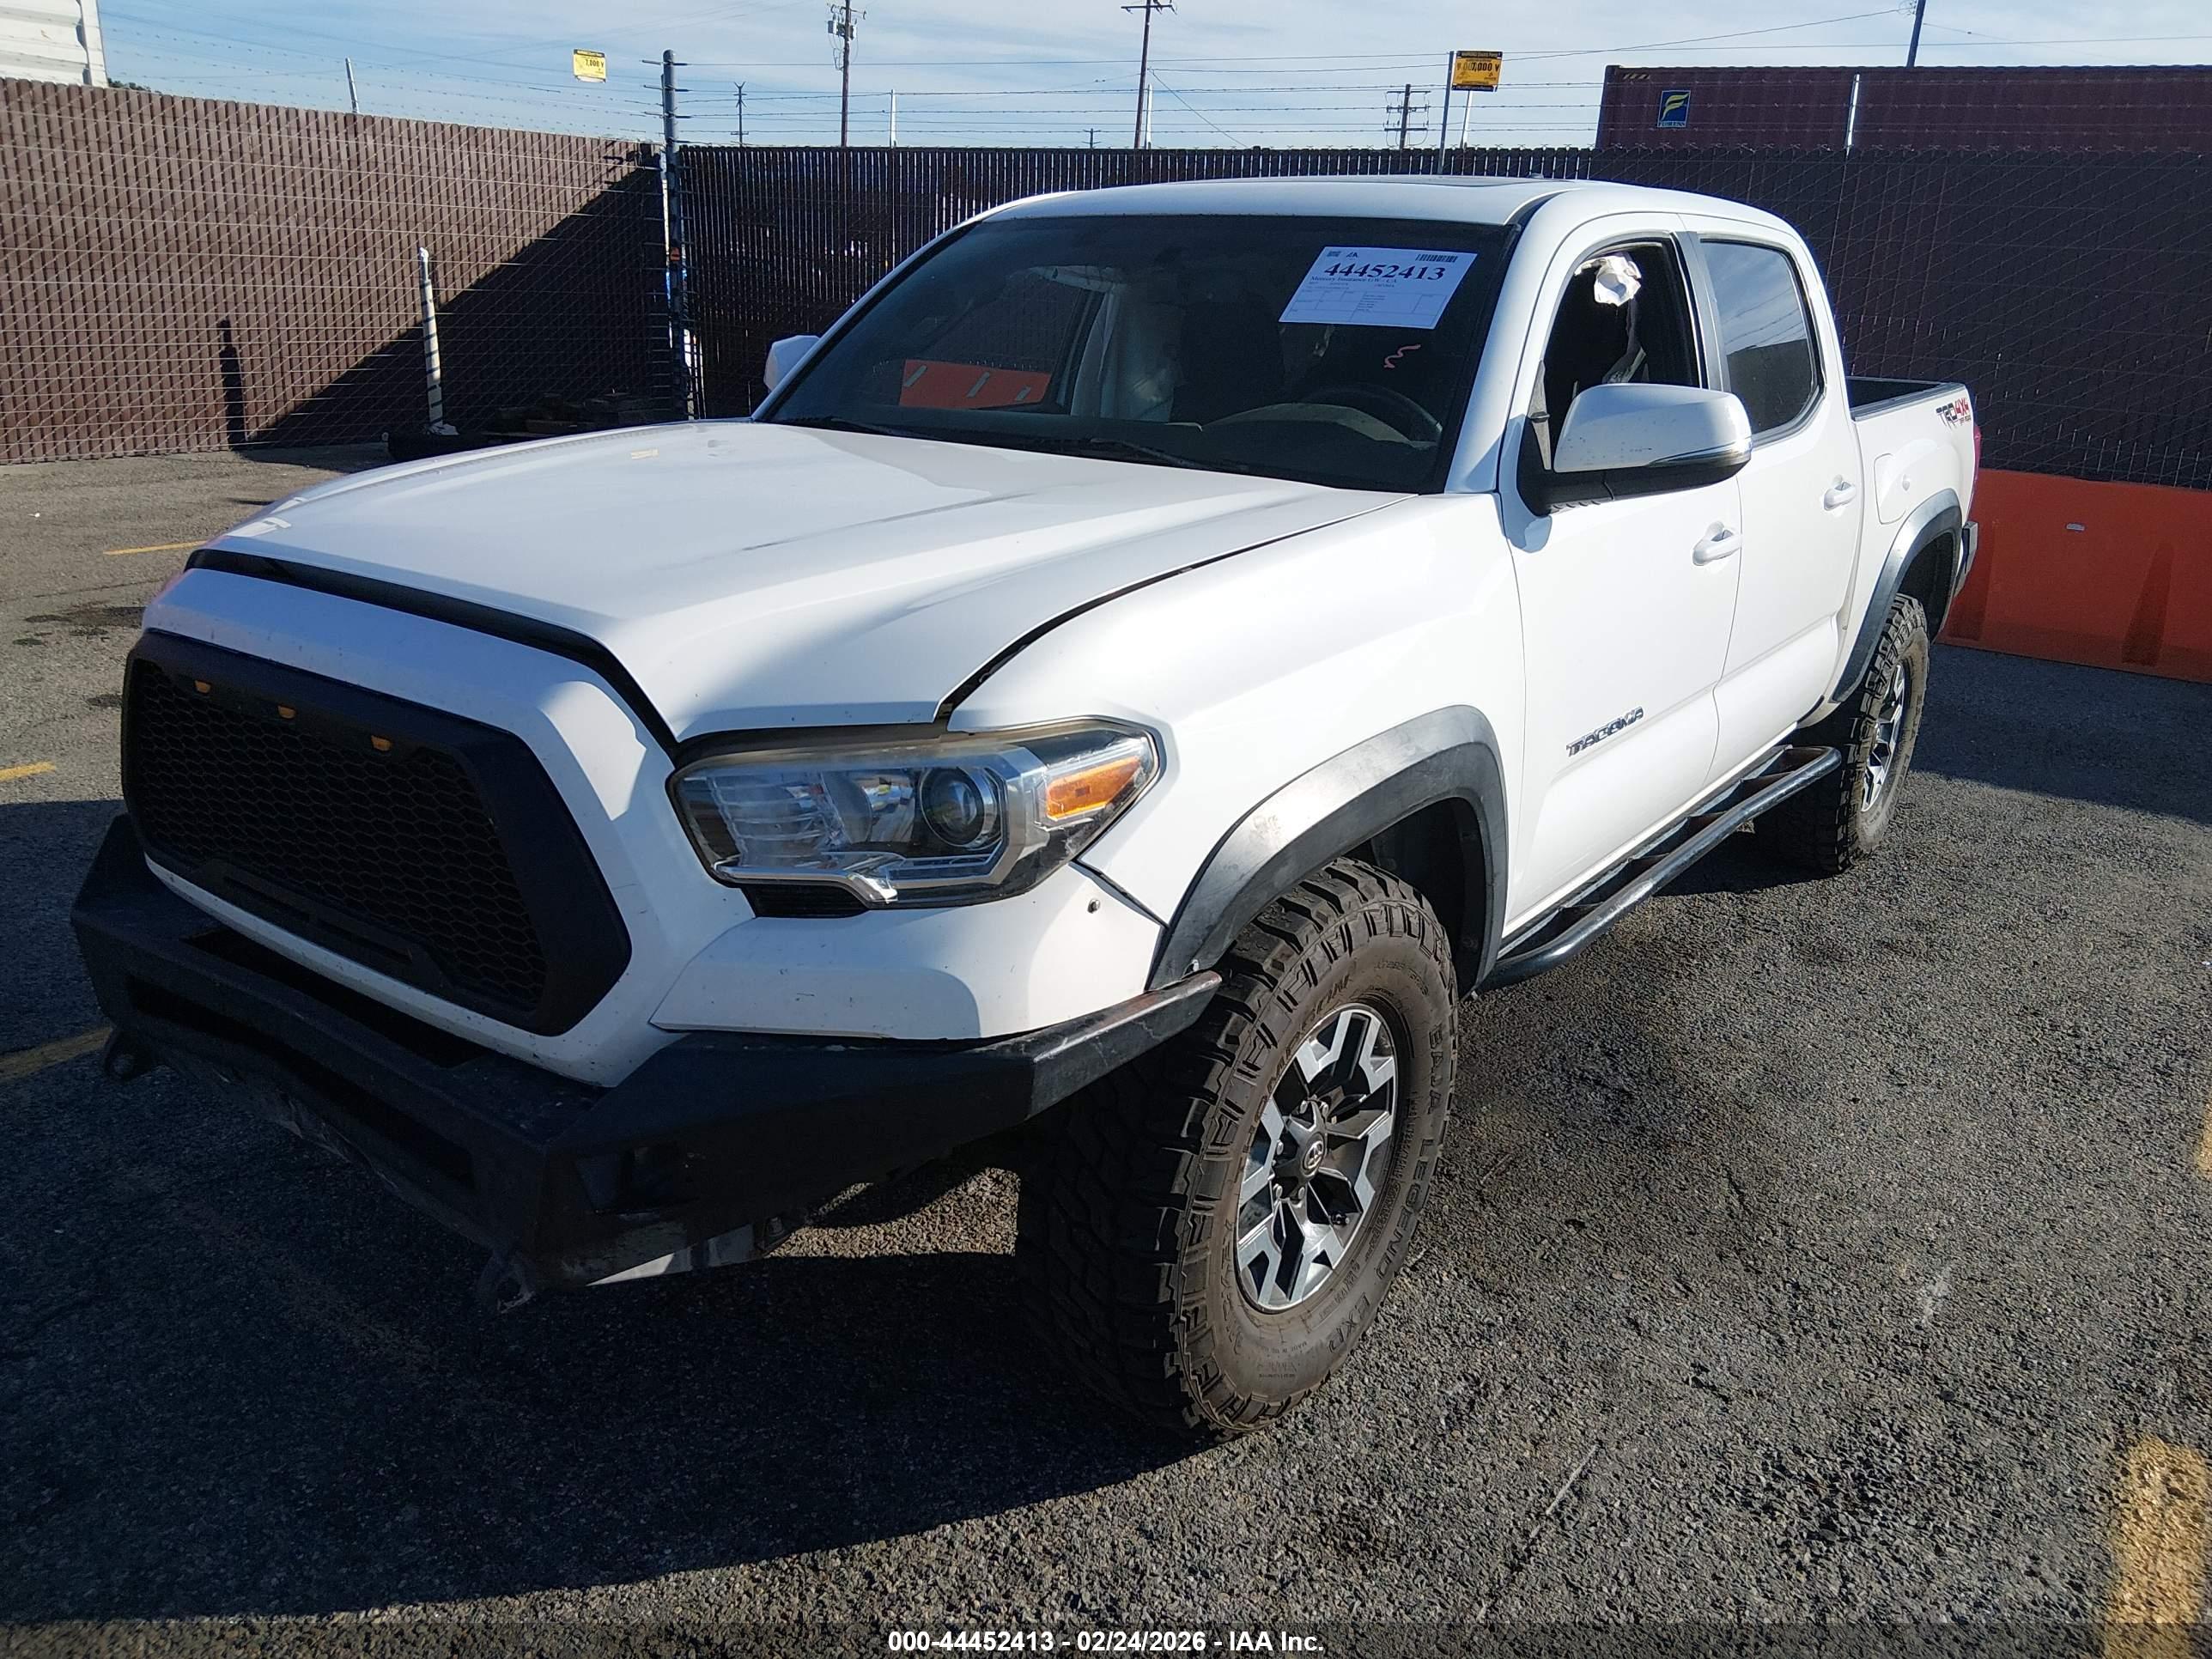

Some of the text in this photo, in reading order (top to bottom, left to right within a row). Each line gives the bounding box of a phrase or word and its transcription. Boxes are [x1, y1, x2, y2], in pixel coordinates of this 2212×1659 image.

[1471, 62, 1493, 71] 7,000
[1324, 262, 1446, 281] 44452413
[1565, 706, 1644, 757] TACOMA
[1427, 1024, 1443, 1115] BAJA
[1376, 1137, 1434, 1278] LEGEND
